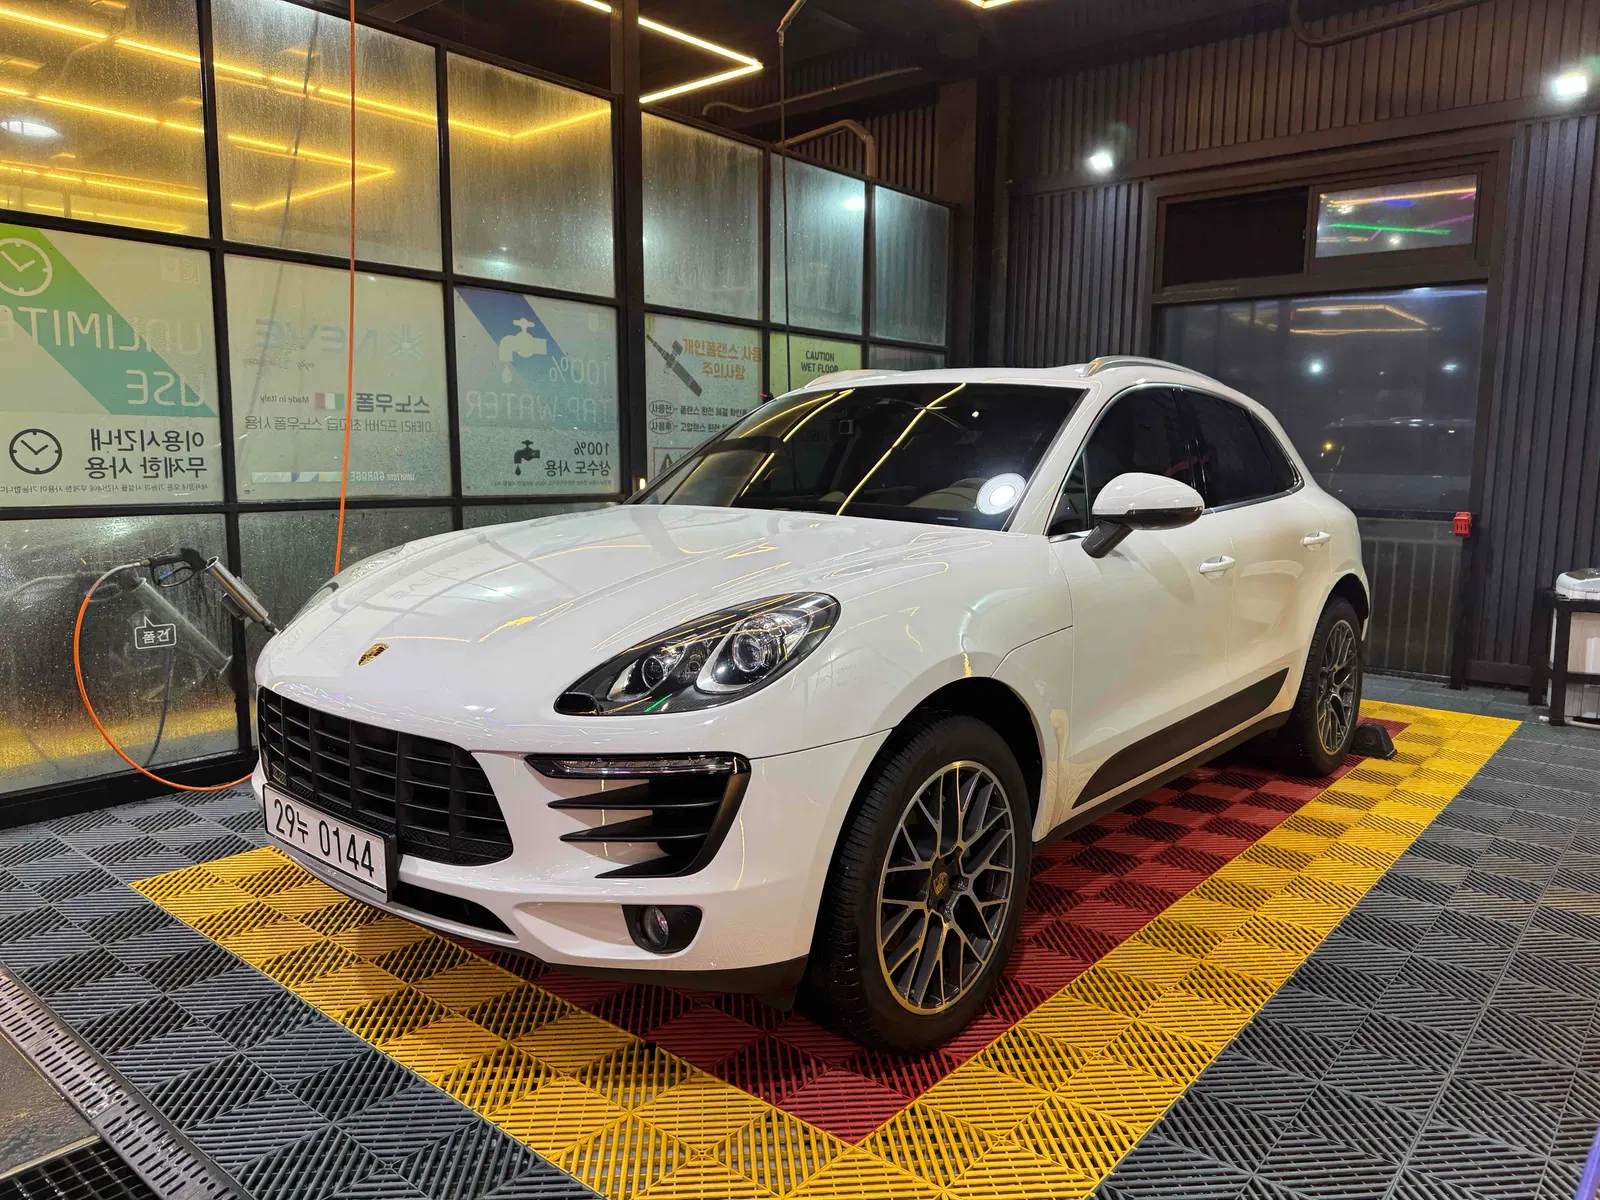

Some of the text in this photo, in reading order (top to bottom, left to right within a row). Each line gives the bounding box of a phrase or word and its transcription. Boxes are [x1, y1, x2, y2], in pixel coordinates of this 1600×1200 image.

[742, 345, 762, 363] 사용
[805, 350, 835, 362] CAUTION
[703, 361, 746, 381] 주의사항
[801, 362, 839, 373] WET FLOOR
[141, 627, 171, 644] 폼건
[318, 820, 375, 878] 0144
